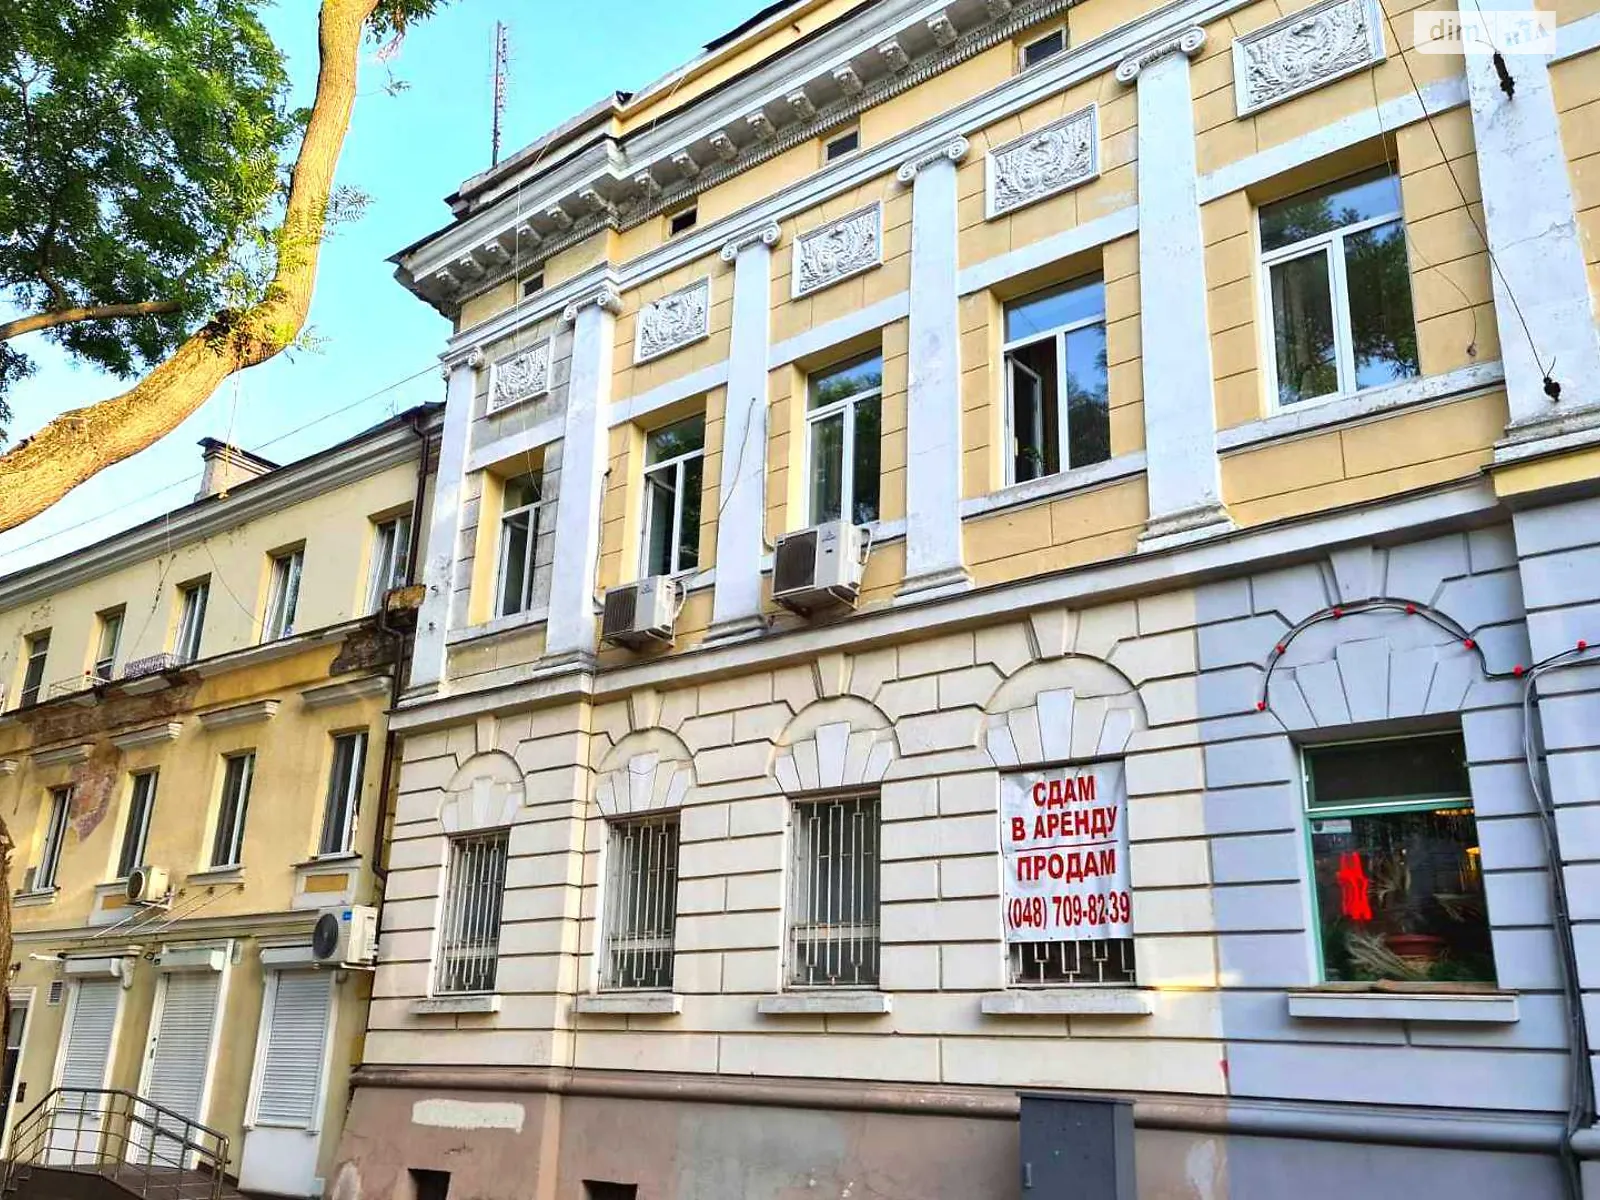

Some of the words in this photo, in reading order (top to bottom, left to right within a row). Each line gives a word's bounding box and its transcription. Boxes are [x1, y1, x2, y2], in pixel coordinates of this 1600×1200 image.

[1033, 775, 1095, 810] СДАМ
[1011, 817, 1026, 841] В
[1033, 806, 1117, 839] АРЕНДУ
[1017, 848, 1116, 883] ПРОДАМ
[1008, 896, 1047, 929] (048)
[1052, 891, 1130, 926] 709-82-39
